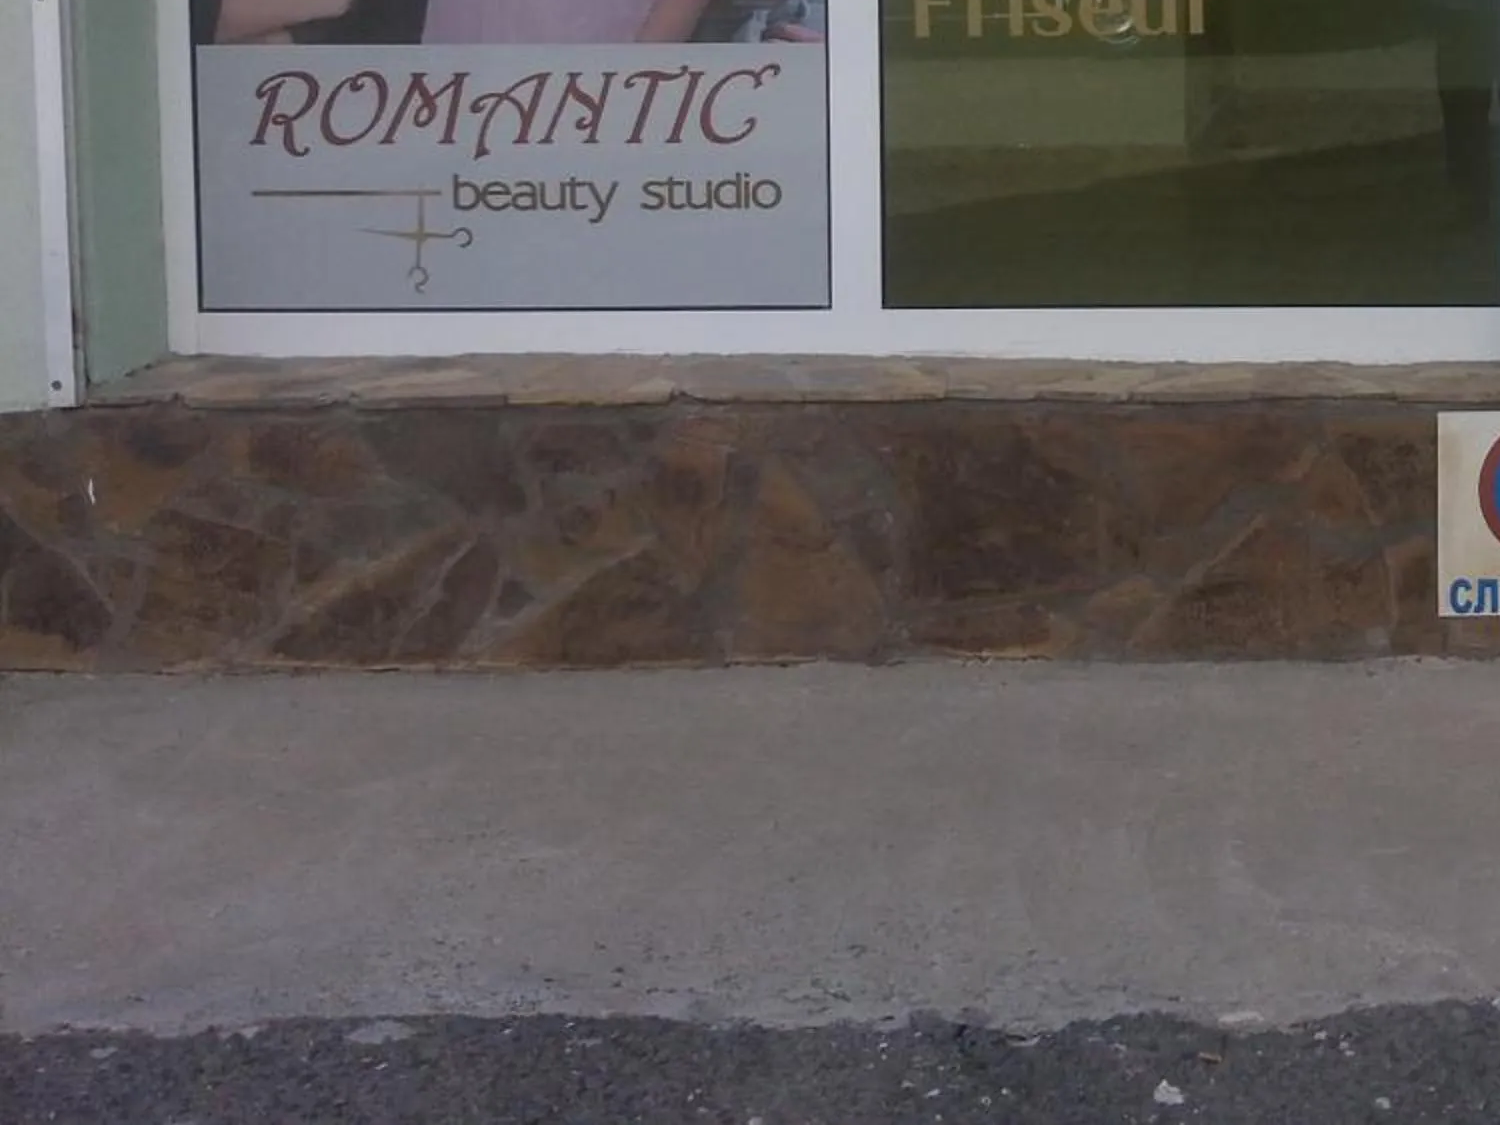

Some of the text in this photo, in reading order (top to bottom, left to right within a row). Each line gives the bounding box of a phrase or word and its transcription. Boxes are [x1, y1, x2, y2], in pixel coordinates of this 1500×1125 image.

[248, 63, 782, 161] ROMANTIC
[452, 173, 783, 223] beauty studio
